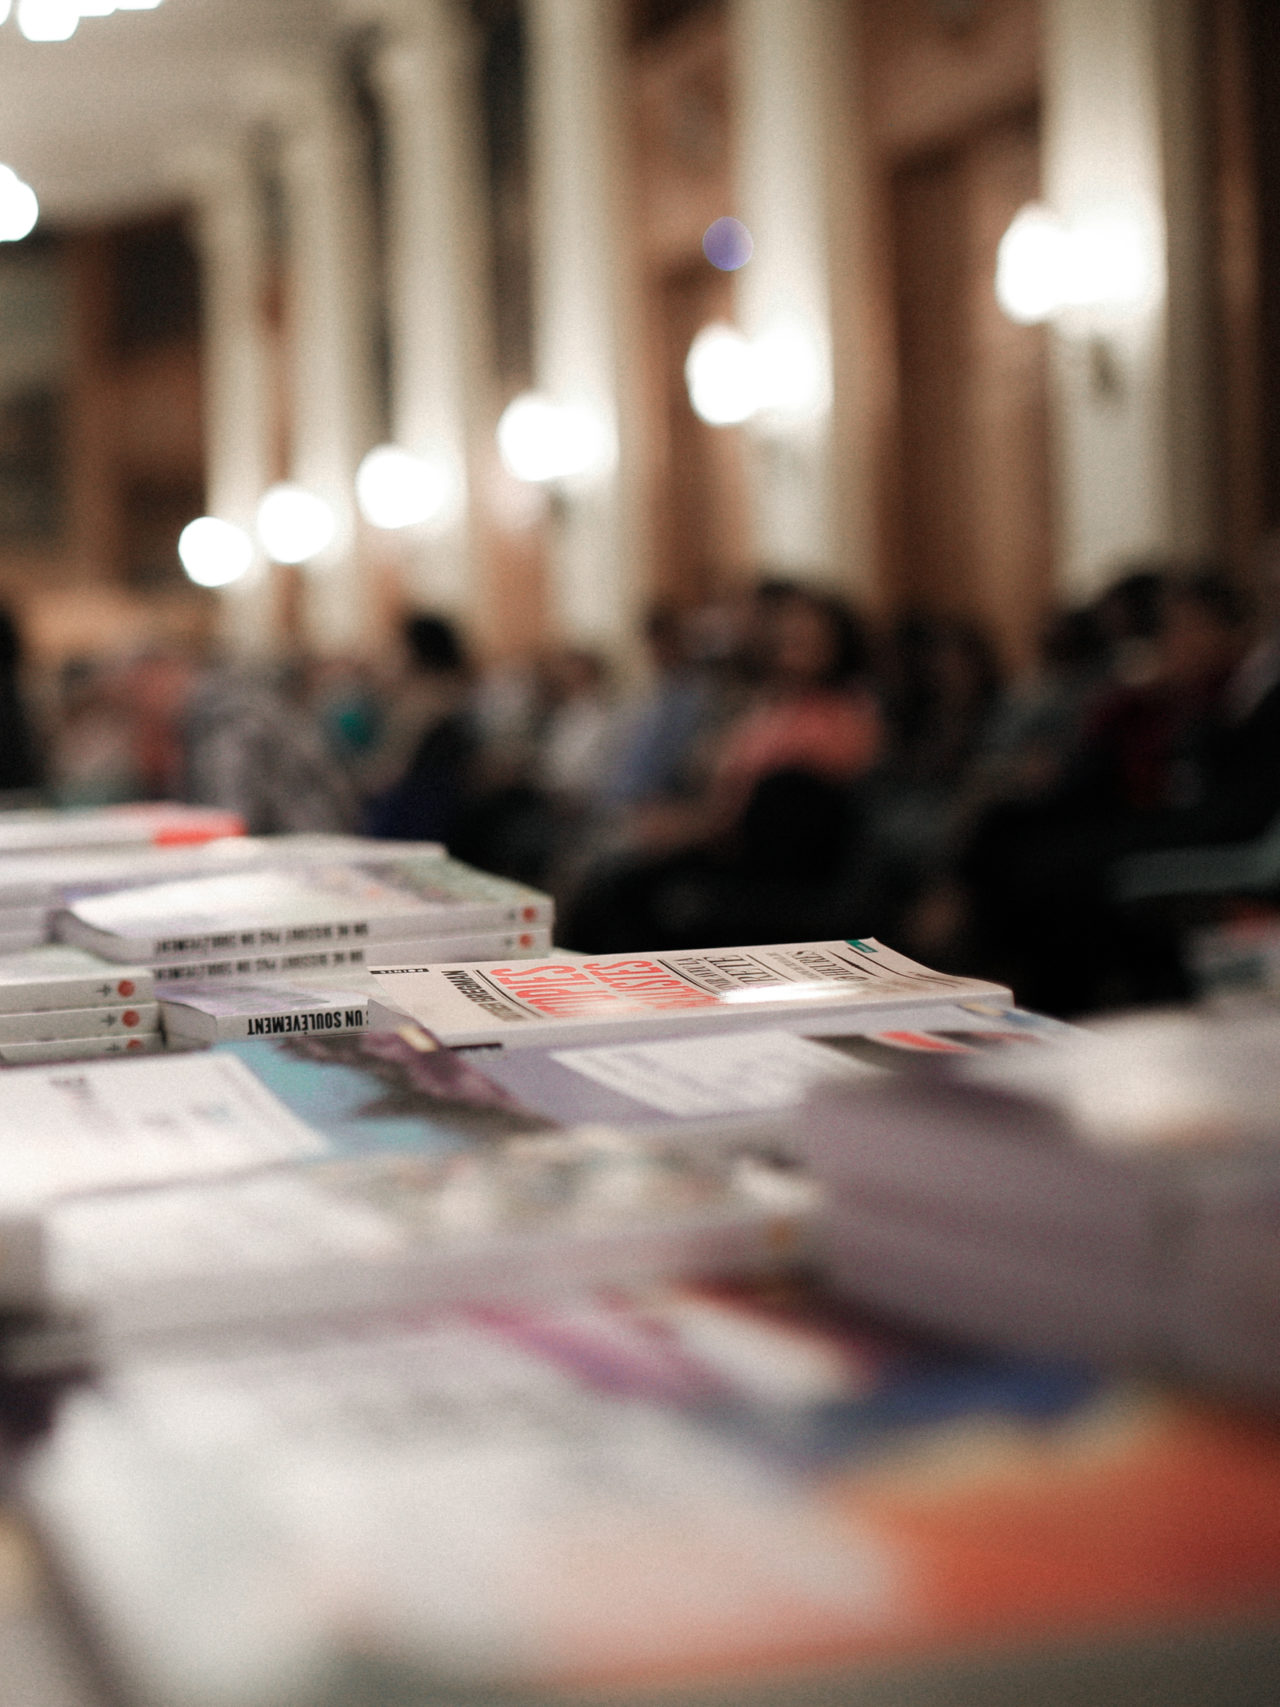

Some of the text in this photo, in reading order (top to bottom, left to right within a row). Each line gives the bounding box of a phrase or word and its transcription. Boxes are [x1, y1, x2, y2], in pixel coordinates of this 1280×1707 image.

[440, 970, 498, 1004] BREGMAN
[247, 1009, 364, 1035] UN SOULÈVEMENT
